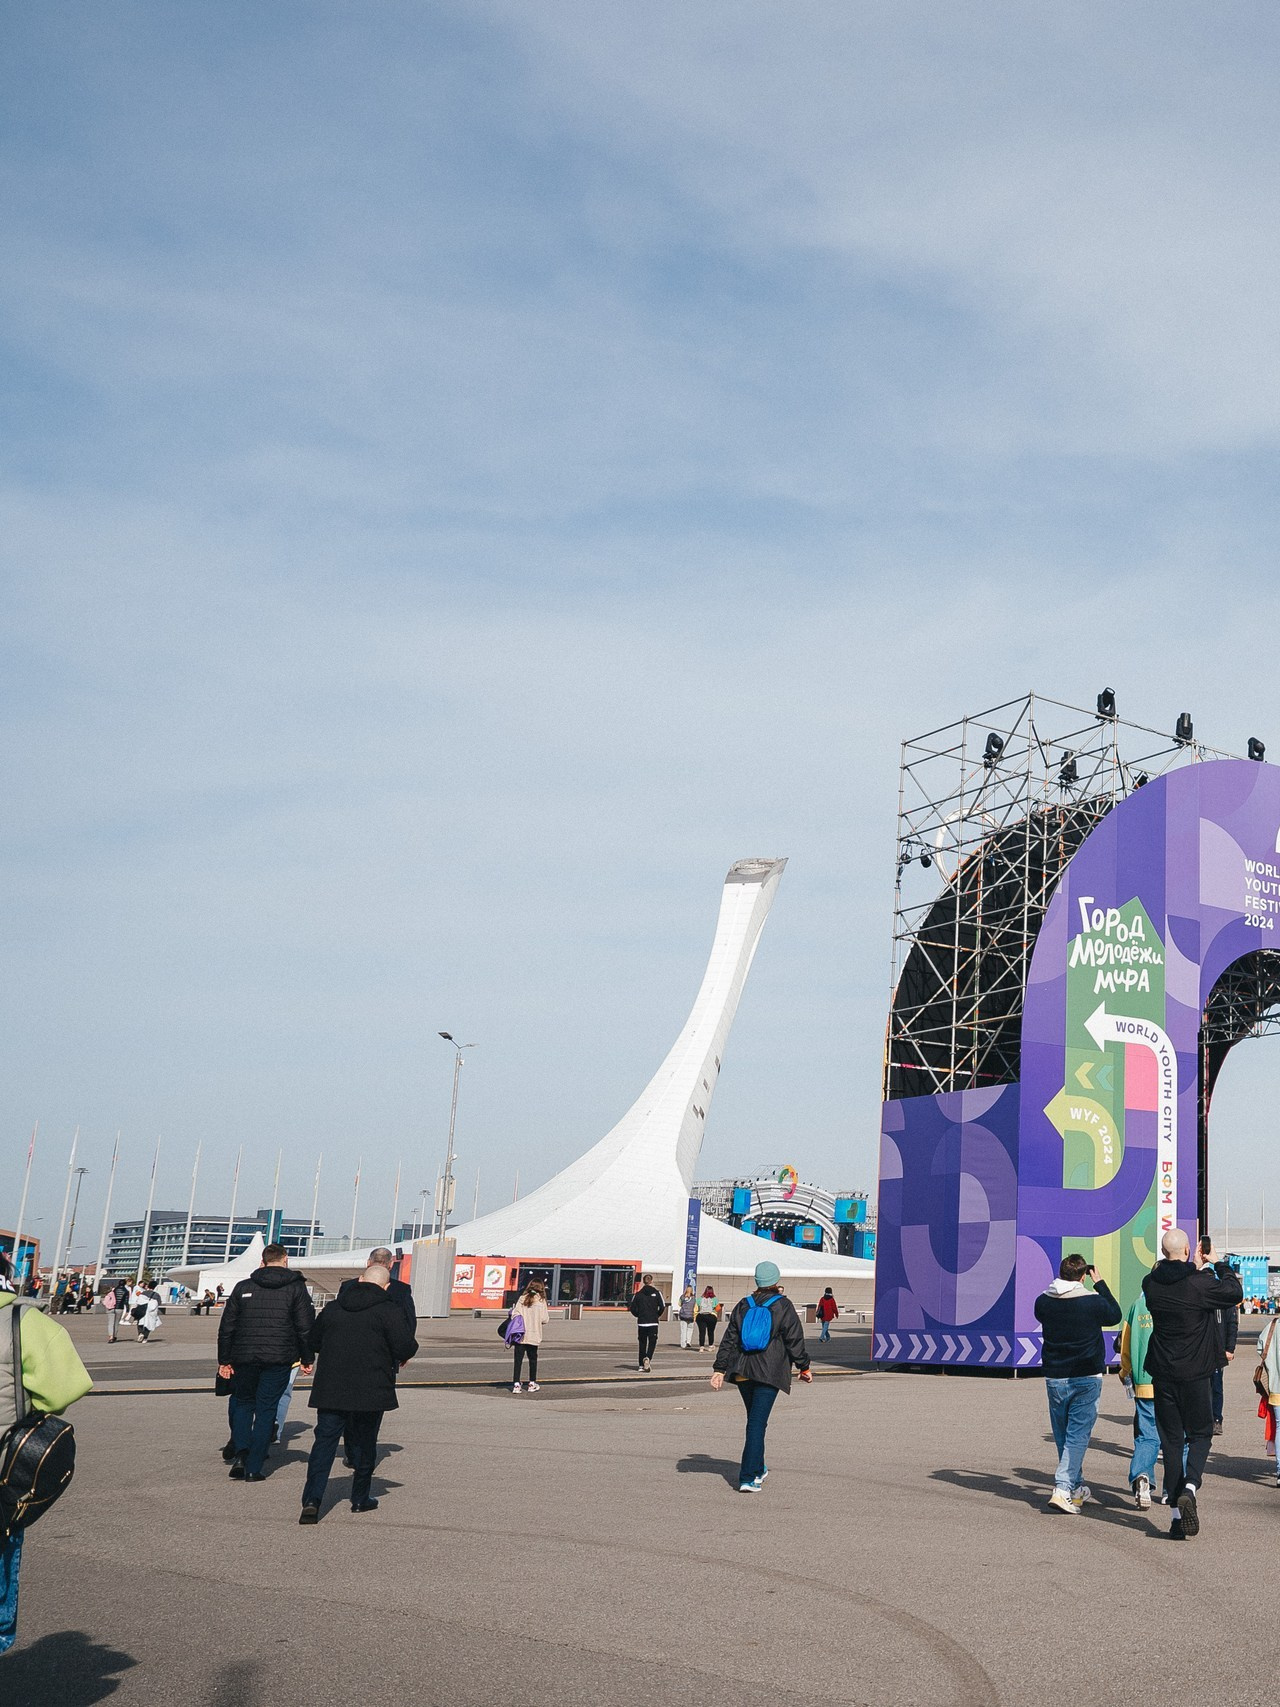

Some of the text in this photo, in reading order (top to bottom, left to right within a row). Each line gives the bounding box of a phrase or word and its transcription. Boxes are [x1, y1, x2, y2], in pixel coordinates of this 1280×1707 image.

[1244, 913, 1274, 930] 2024
[1115, 1020, 1173, 1143] WORLD YOUTH CITY
[1069, 1107, 1113, 1165] WYF 2024
